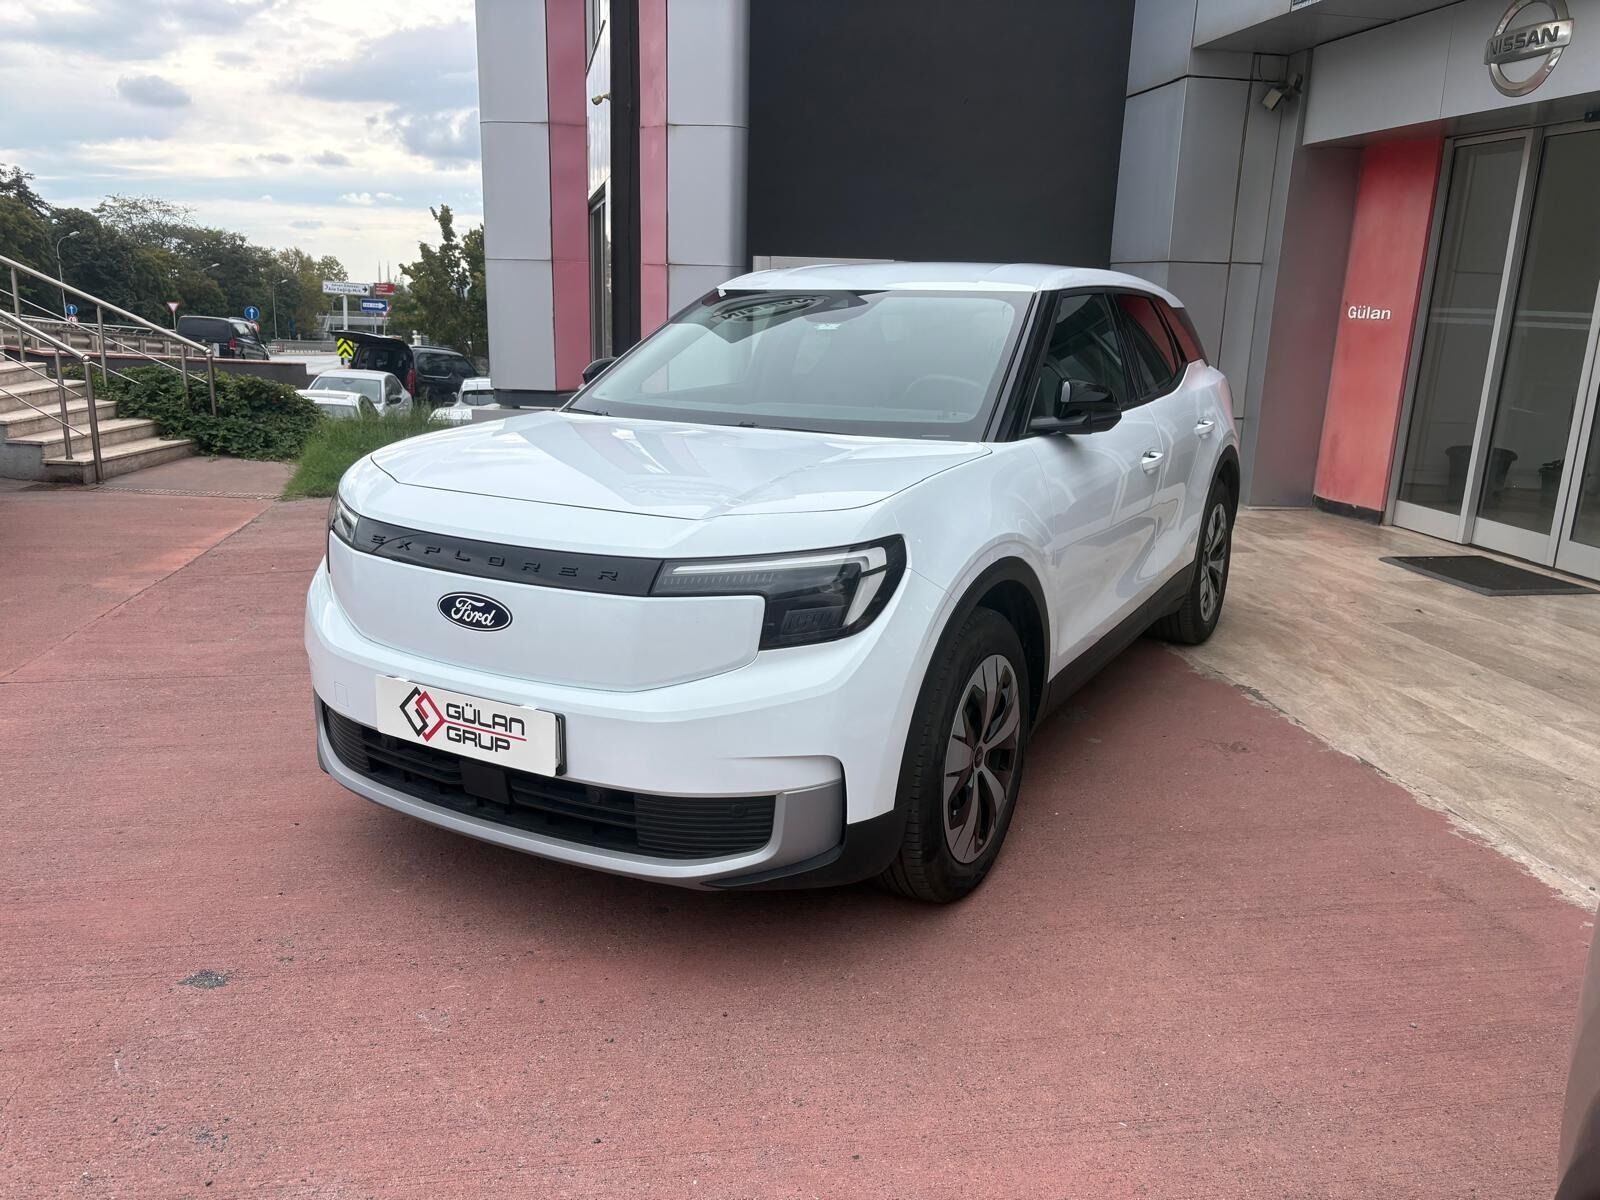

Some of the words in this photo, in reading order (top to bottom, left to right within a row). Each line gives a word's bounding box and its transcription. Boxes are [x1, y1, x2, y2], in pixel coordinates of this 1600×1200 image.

[1488, 25, 1560, 55] NISSAN
[1347, 304, 1391, 320] Gülan
[371, 534, 618, 582] EXPLORER
[450, 597, 496, 627] Ford
[446, 702, 525, 736] GÜLAN
[446, 725, 511, 753] GRUP
